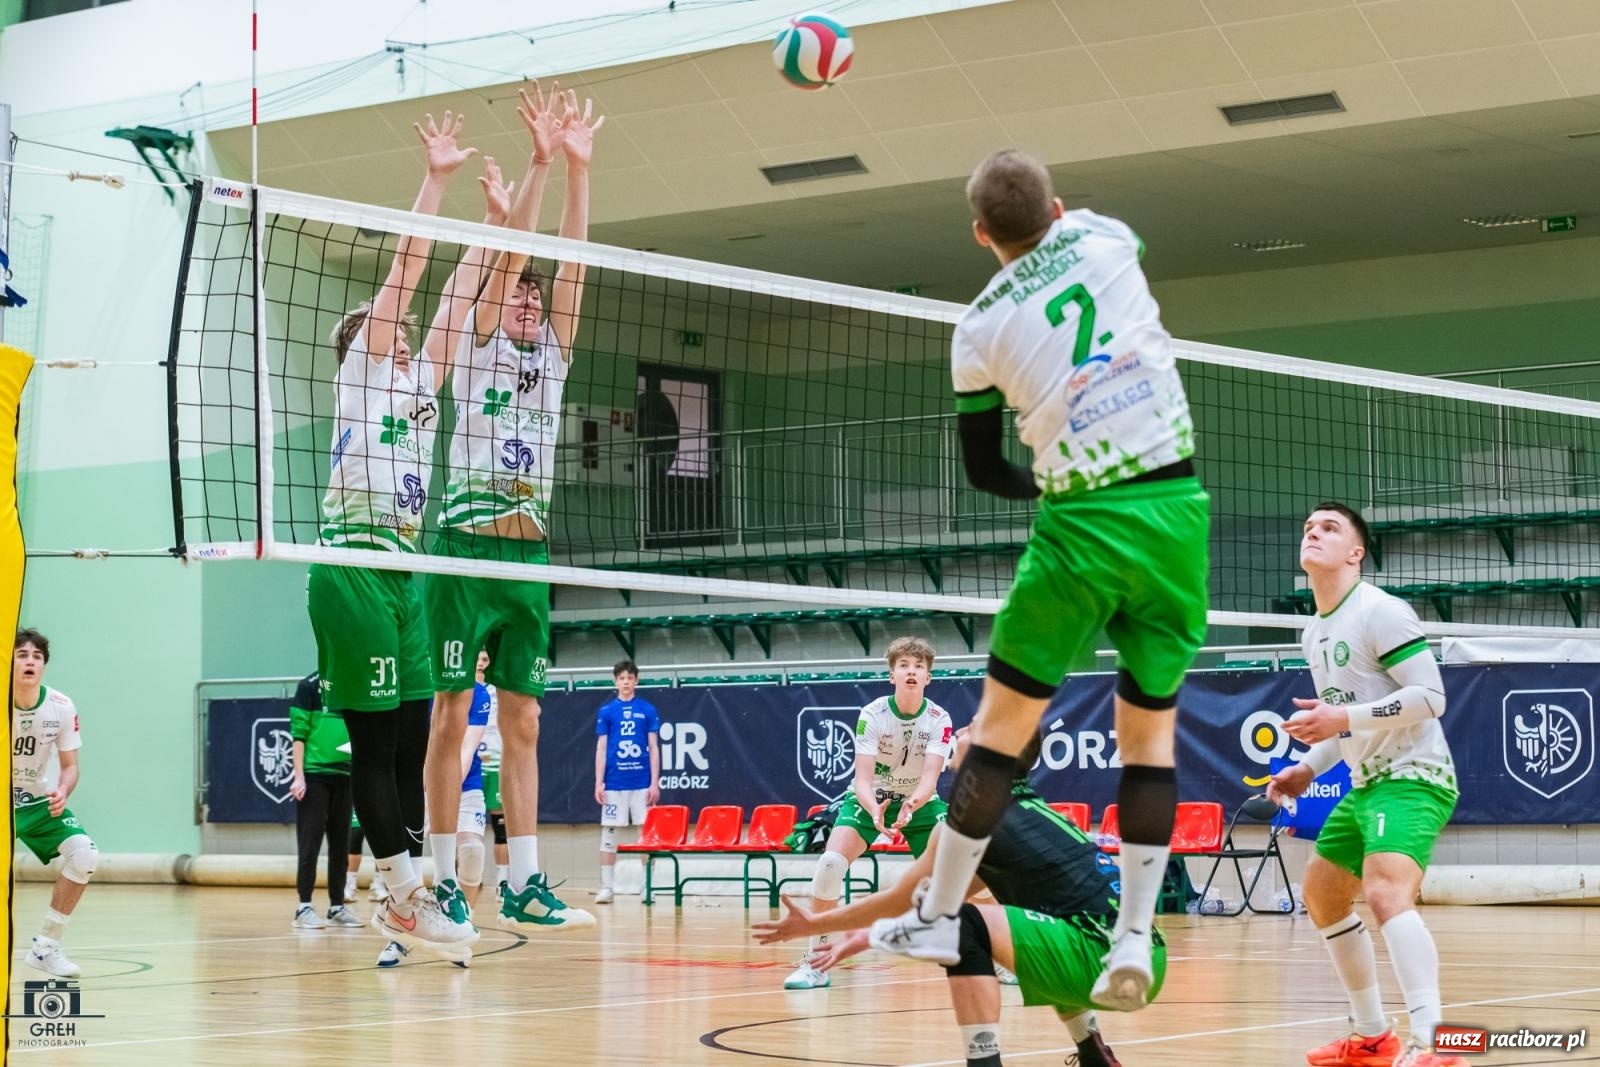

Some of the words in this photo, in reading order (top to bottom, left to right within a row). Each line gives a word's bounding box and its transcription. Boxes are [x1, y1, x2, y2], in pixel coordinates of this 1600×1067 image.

[213, 186, 244, 199] netex
[199, 548, 228, 557] netex
[443, 640, 464, 669] 18
[370, 656, 397, 687] 37
[620, 721, 636, 736] 22
[13, 736, 36, 756] 99
[659, 722, 709, 770] iR
[659, 772, 709, 789] CIBÓRZ
[1300, 782, 1341, 799] olten
[1376, 812, 1386, 837] 1
